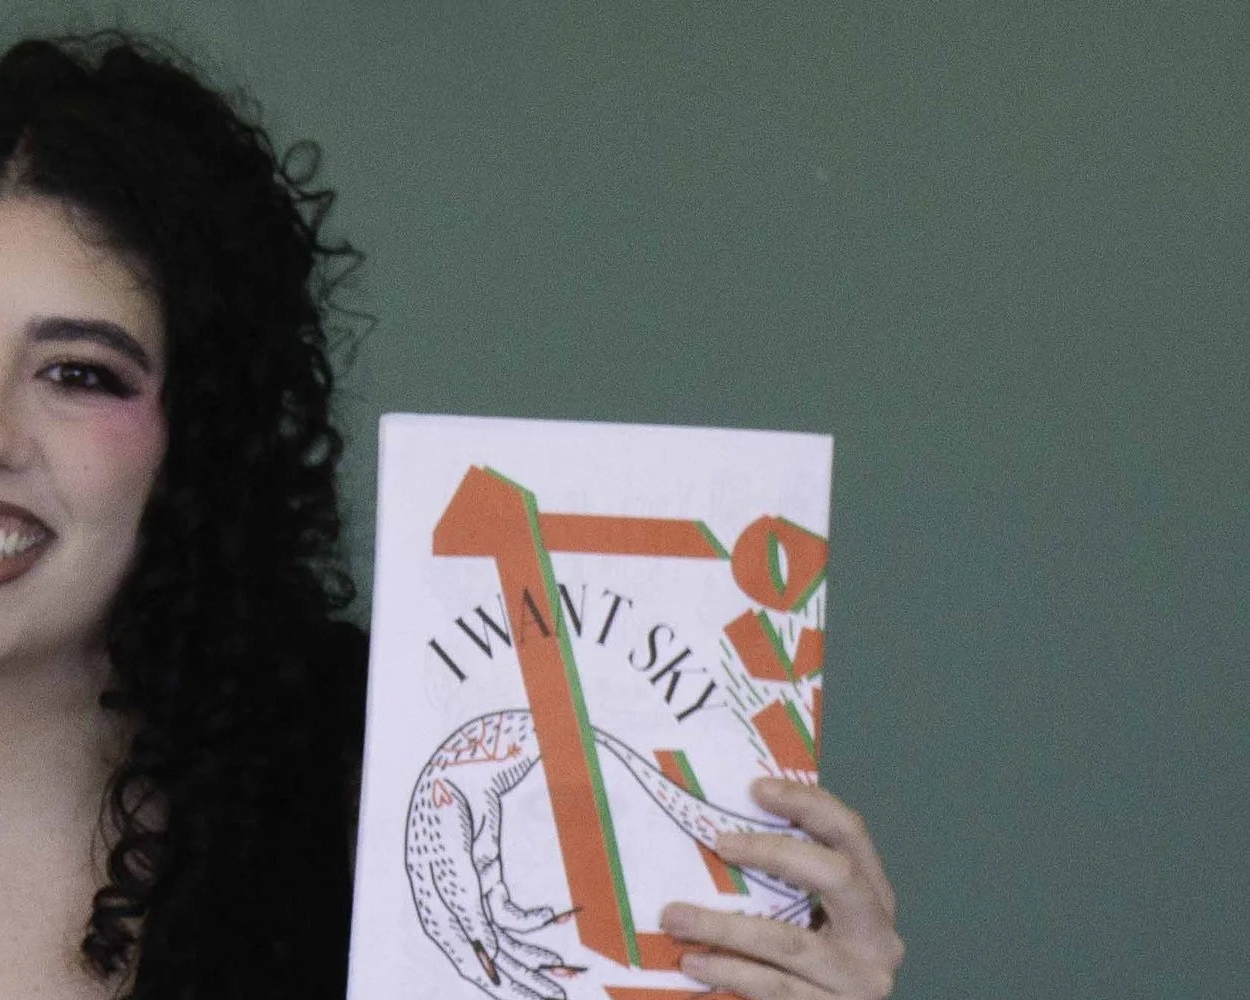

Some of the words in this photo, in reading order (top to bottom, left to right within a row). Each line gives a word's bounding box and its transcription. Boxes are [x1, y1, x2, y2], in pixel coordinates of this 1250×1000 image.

[428, 637, 467, 683] I
[454, 583, 633, 660] WANT
[628, 624, 728, 725] SKY
